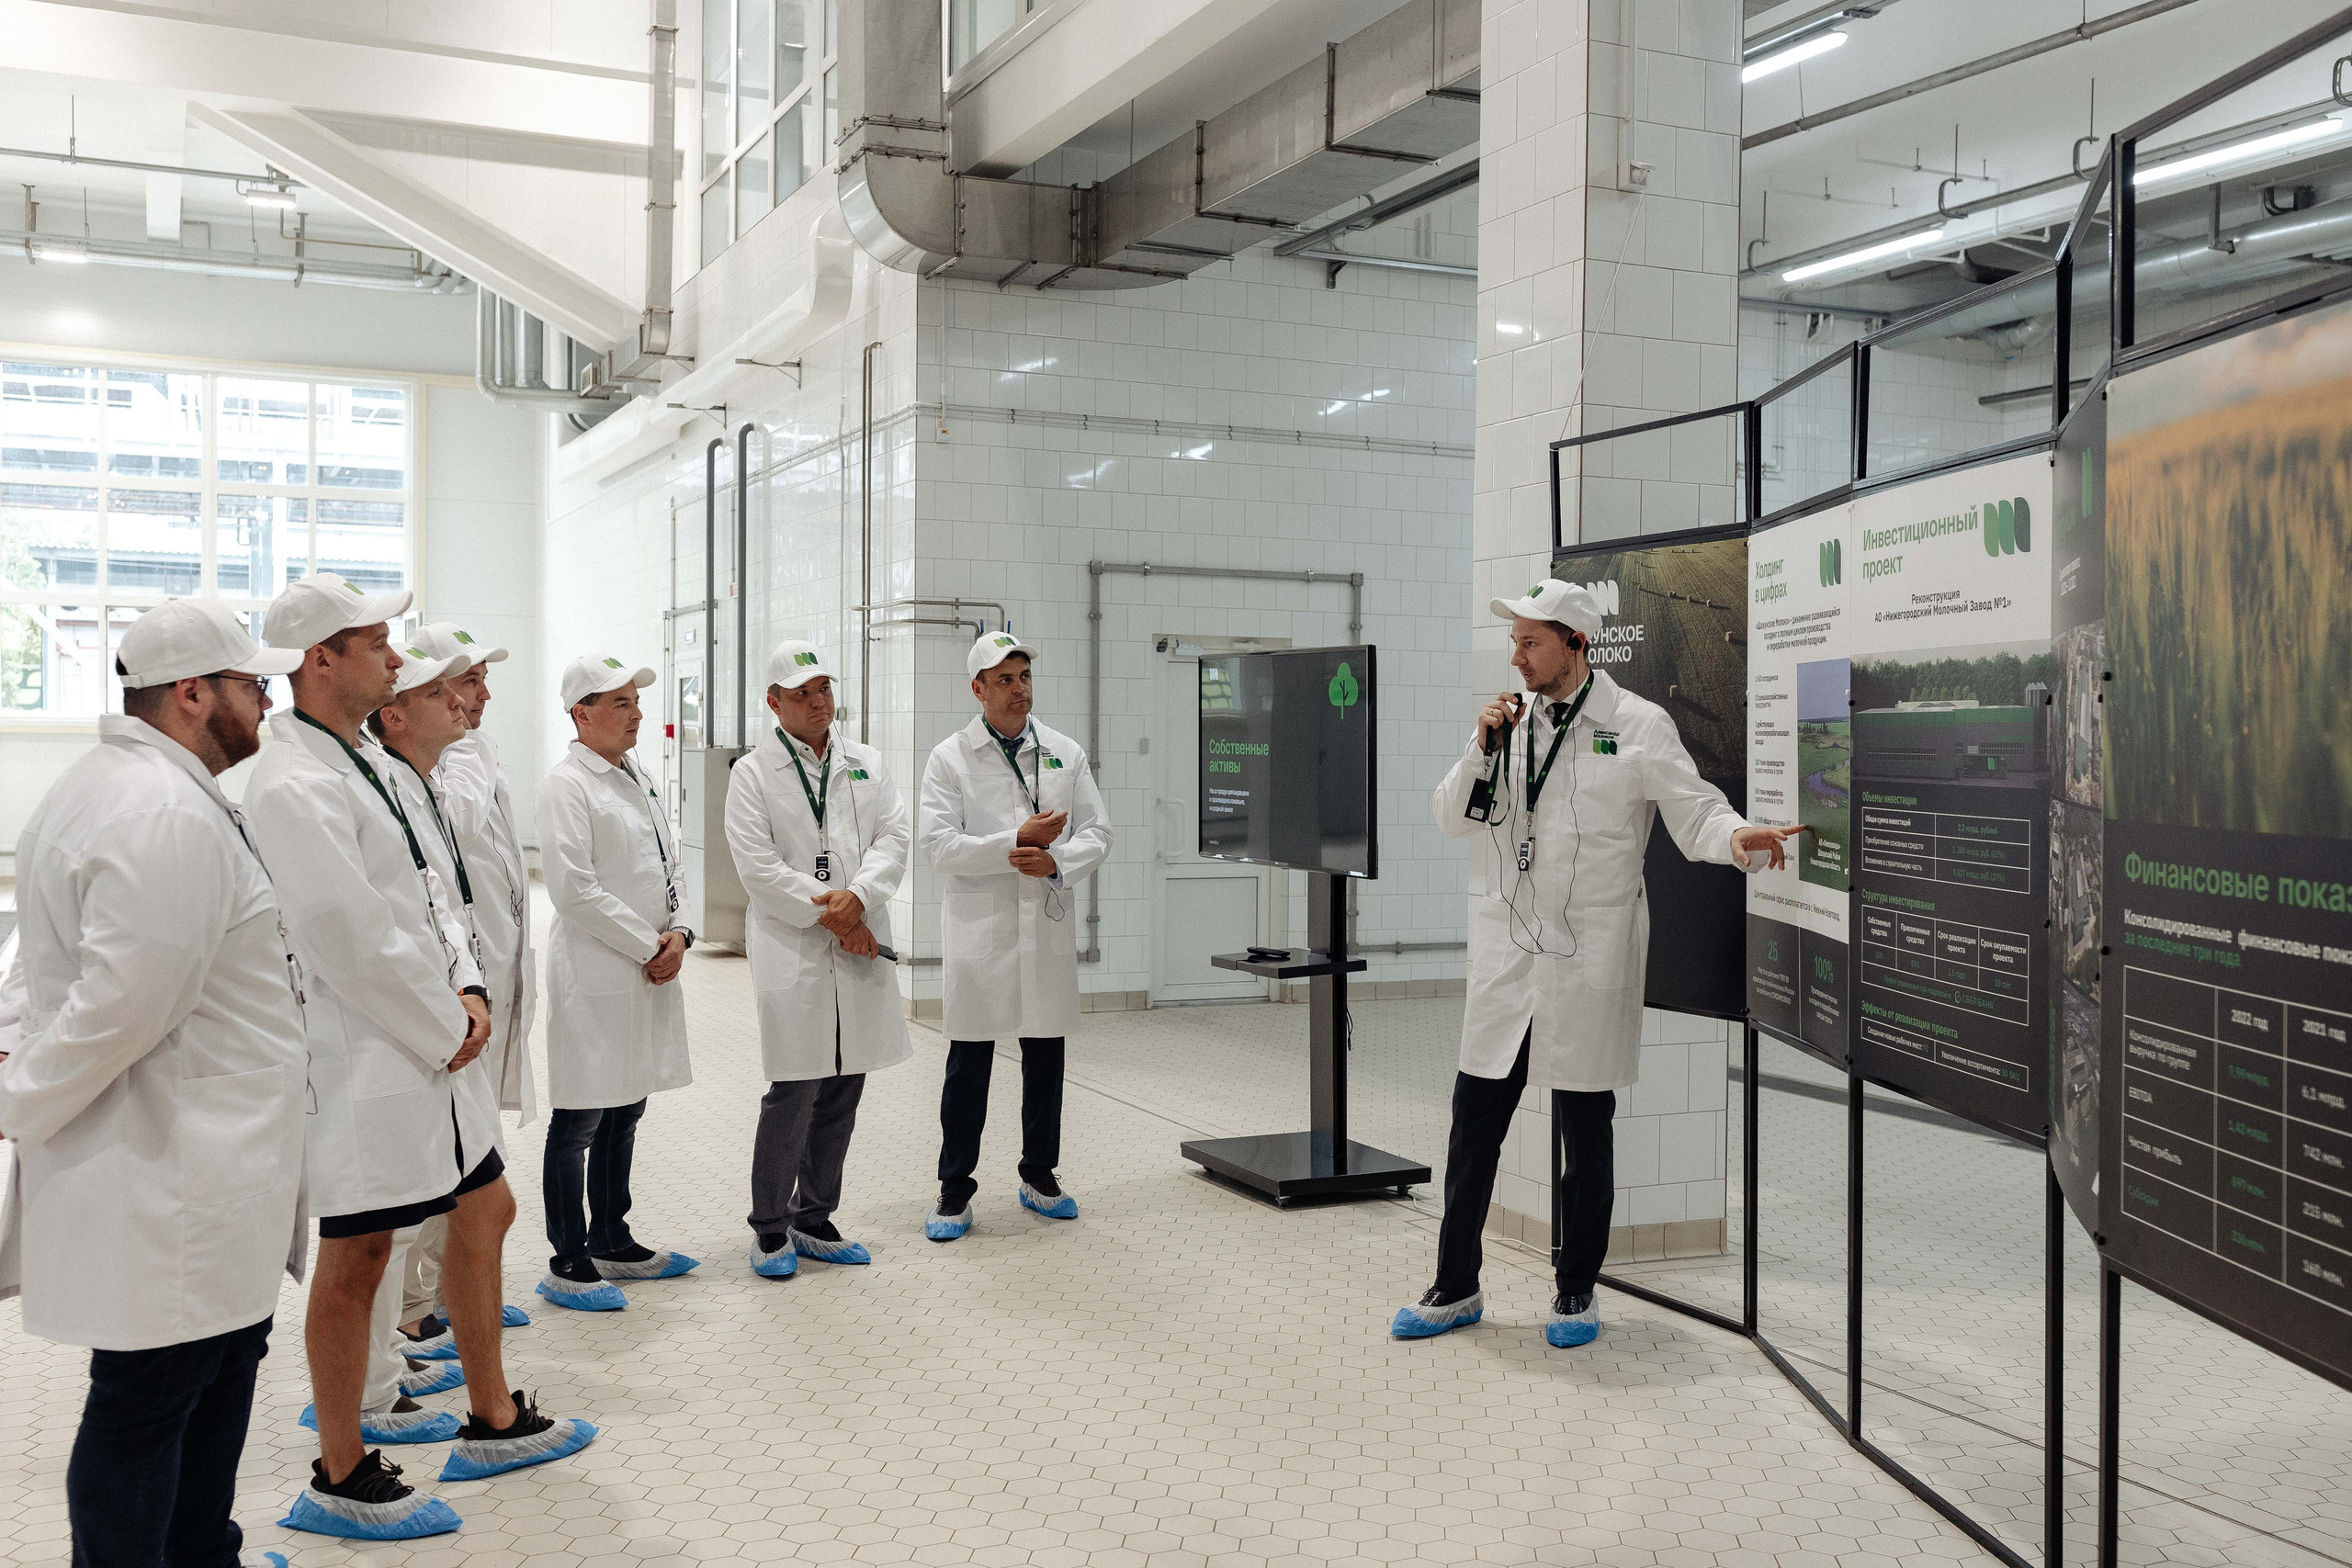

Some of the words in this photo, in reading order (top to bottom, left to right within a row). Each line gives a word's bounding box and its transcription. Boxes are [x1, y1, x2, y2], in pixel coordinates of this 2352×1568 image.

[1863, 504, 1978, 551] Инвестиционный
[1756, 558, 1783, 580] Холдинг
[1863, 556, 1904, 583] проект
[1756, 589, 1759, 603] в
[1760, 581, 1788, 604] цифрах
[1911, 590, 1961, 605] Реконструкция
[1874, 612, 1883, 623] АО
[1883, 605, 1932, 621] «Нижегородский
[1933, 601, 1969, 616] Молочный
[1970, 599, 1993, 612] Завод
[1994, 596, 2012, 610] №1»
[1589, 625, 1645, 645] УНСКОЕ
[1587, 645, 1632, 664] ОЛОКО
[1209, 738, 1270, 756] Собственные
[1209, 760, 1241, 773] активы
[1862, 791, 1884, 804] Объемы
[1865, 814, 1877, 824] Общая
[1877, 817, 1889, 826] сумма
[1889, 818, 1911, 827] инвестиций
[1980, 825, 1998, 836] рублей
[1912, 863, 1923, 873] часть
[2125, 852, 2270, 902] Финансовые
[1862, 888, 1889, 905] Структура
[1888, 894, 1936, 912] инвестирования
[1868, 917, 1892, 929] Собственные
[1900, 923, 1930, 937] Привлеченные
[1871, 928, 1888, 938] средства
[1905, 935, 1925, 946] средства
[1938, 931, 1949, 941] Срок
[1949, 934, 1976, 946] реализации
[2124, 908, 2233, 944] Консолидированные
[2238, 929, 2321, 959] финансовые
[1768, 940, 1779, 962] 25
[1947, 944, 1966, 955] проекта
[1981, 939, 1993, 950] Срок
[1993, 942, 2027, 955] окупаемости
[2137, 933, 2191, 957] последние
[2192, 945, 2212, 964] три
[1992, 953, 2014, 964] проекта
[1815, 955, 1834, 984] 100%
[1861, 999, 1887, 1018] Эффекты
[1888, 1010, 1894, 1020] от
[1894, 1012, 1931, 1032] реализации
[1931, 1023, 1958, 1039] проекта
[1896, 1035, 1912, 1047] рабочих
[1941, 1050, 1967, 1066] Увеличение
[2129, 1044, 2156, 1060] выручка
[2128, 1134, 2152, 1154] Чистая
[2152, 1146, 2183, 1166] прибыль
